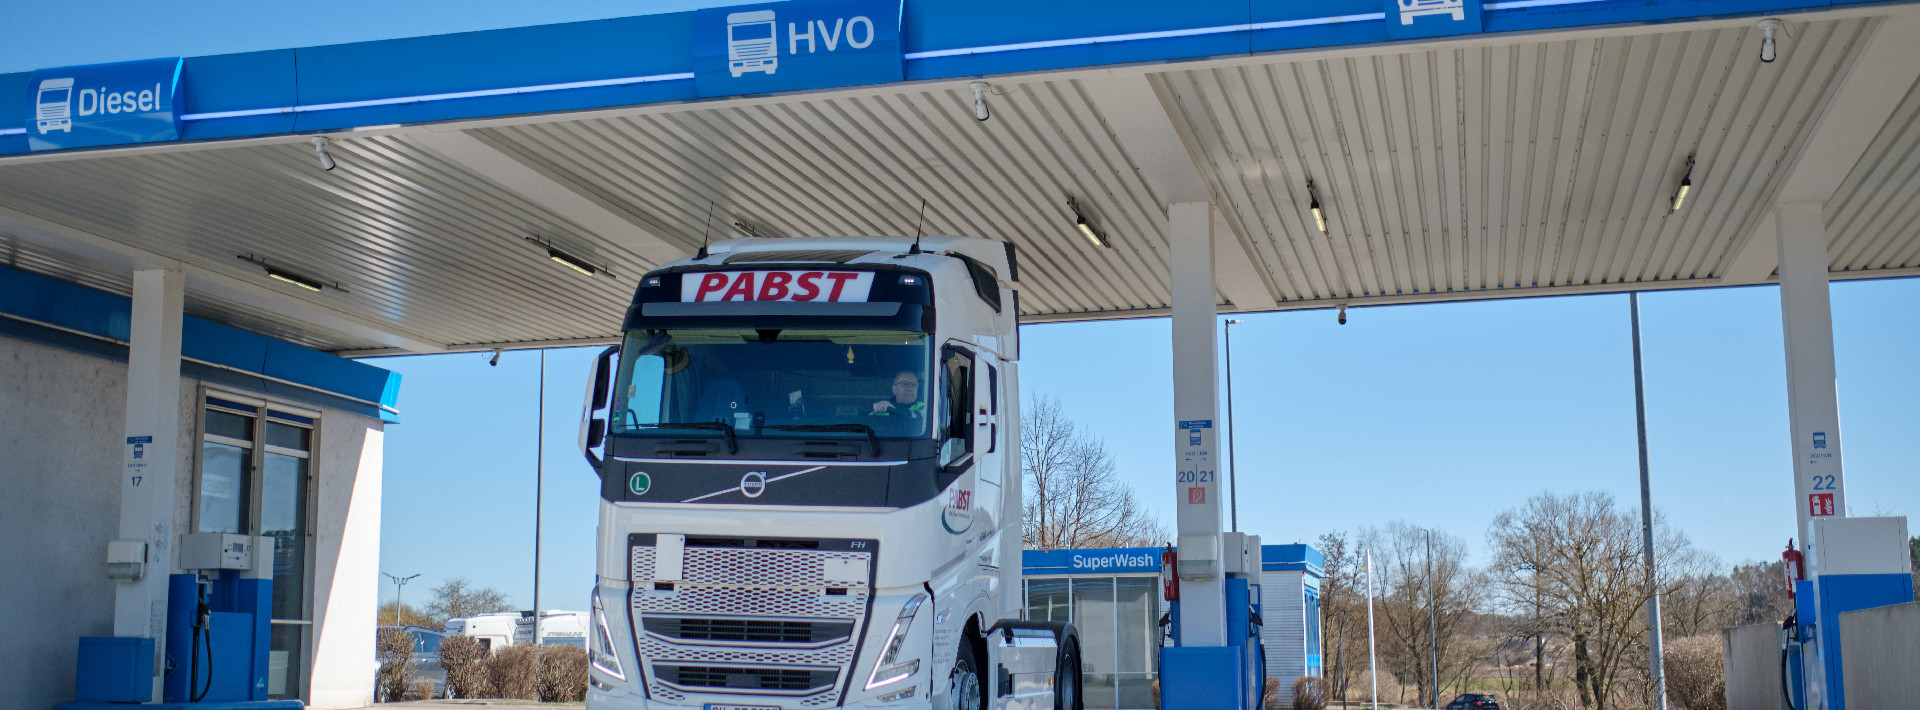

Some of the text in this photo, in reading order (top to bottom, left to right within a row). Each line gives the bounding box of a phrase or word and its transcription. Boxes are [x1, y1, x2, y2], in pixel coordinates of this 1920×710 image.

[788, 15, 875, 55] HVO
[79, 82, 161, 117] Diesel
[694, 271, 859, 302] PABST
[131, 476, 143, 487] 17
[636, 477, 645, 491] L
[1178, 470, 1214, 483] 20 21
[1812, 474, 1836, 490] 22
[949, 488, 971, 511] PABST
[850, 541, 866, 549] FH
[1073, 553, 1154, 571] SuperWash
